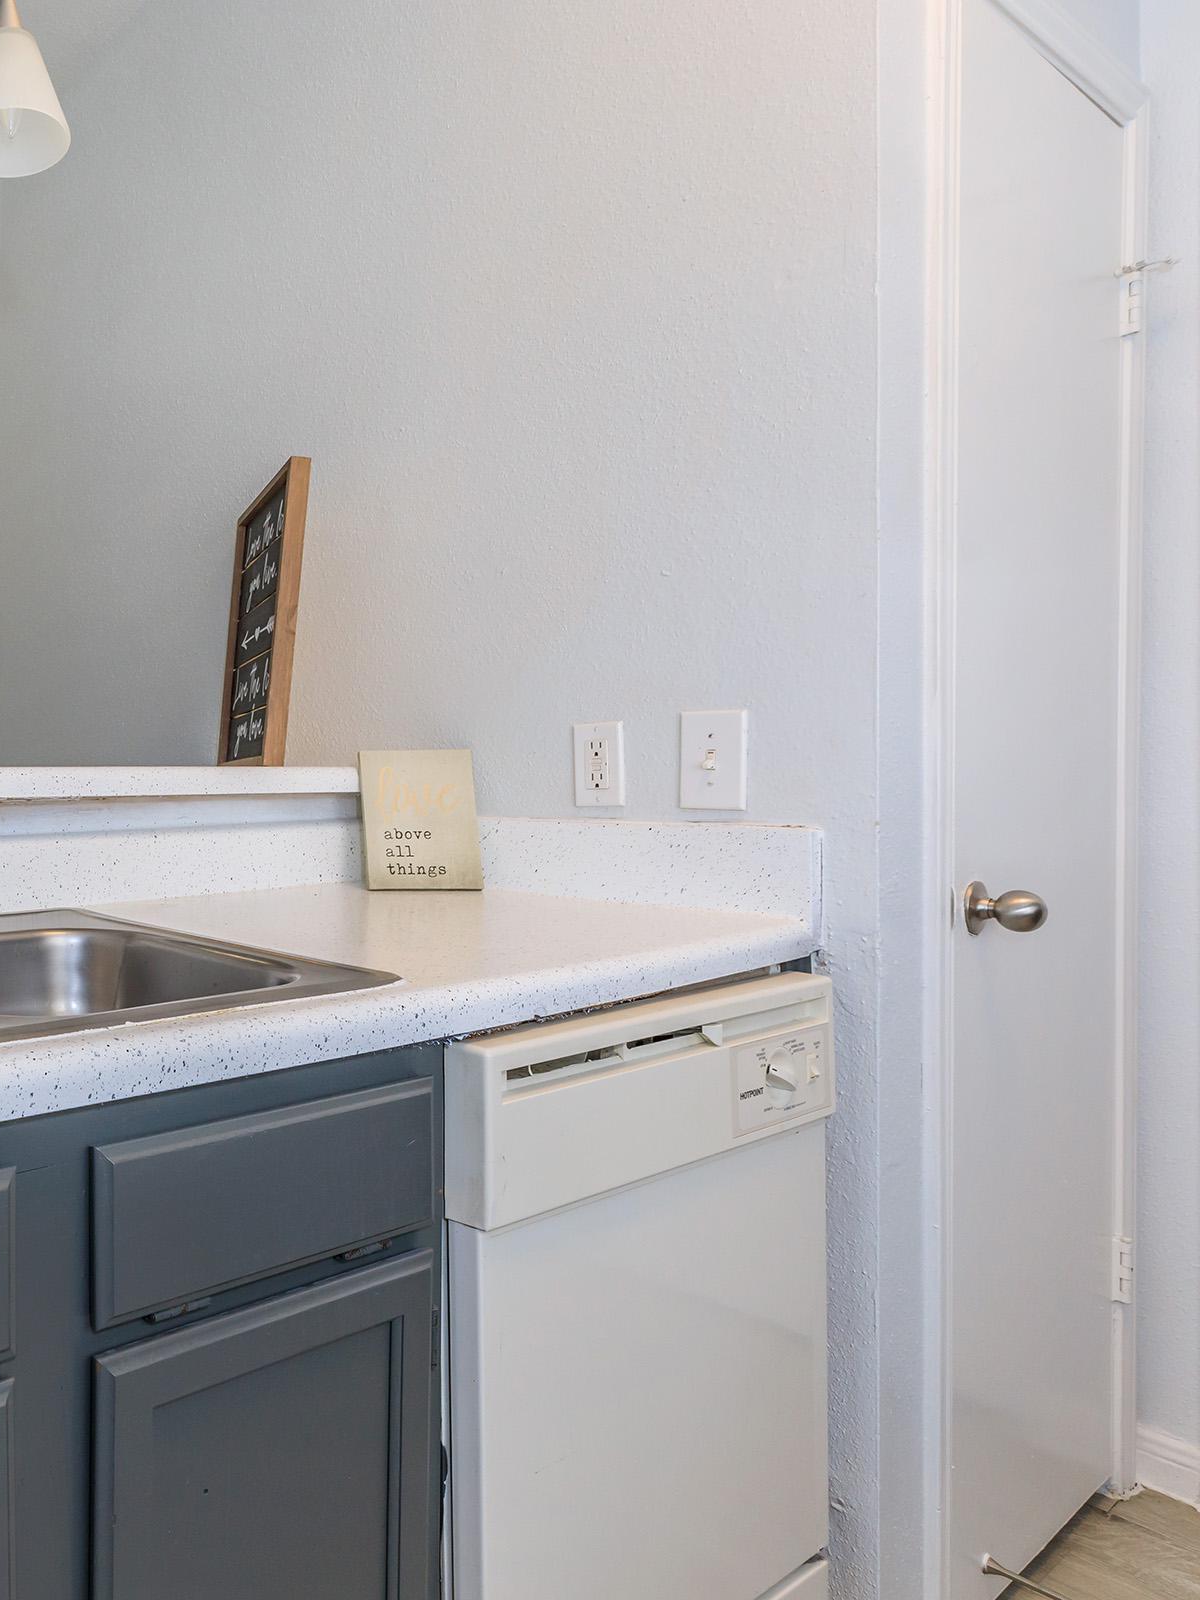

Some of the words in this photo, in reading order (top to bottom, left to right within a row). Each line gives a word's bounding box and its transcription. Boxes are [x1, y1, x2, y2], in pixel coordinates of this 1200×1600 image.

[374, 767, 463, 824] love
[384, 828, 432, 841] above
[385, 845, 415, 858] all
[386, 863, 447, 878] things
[739, 1086, 764, 1101] HOTPOINT
